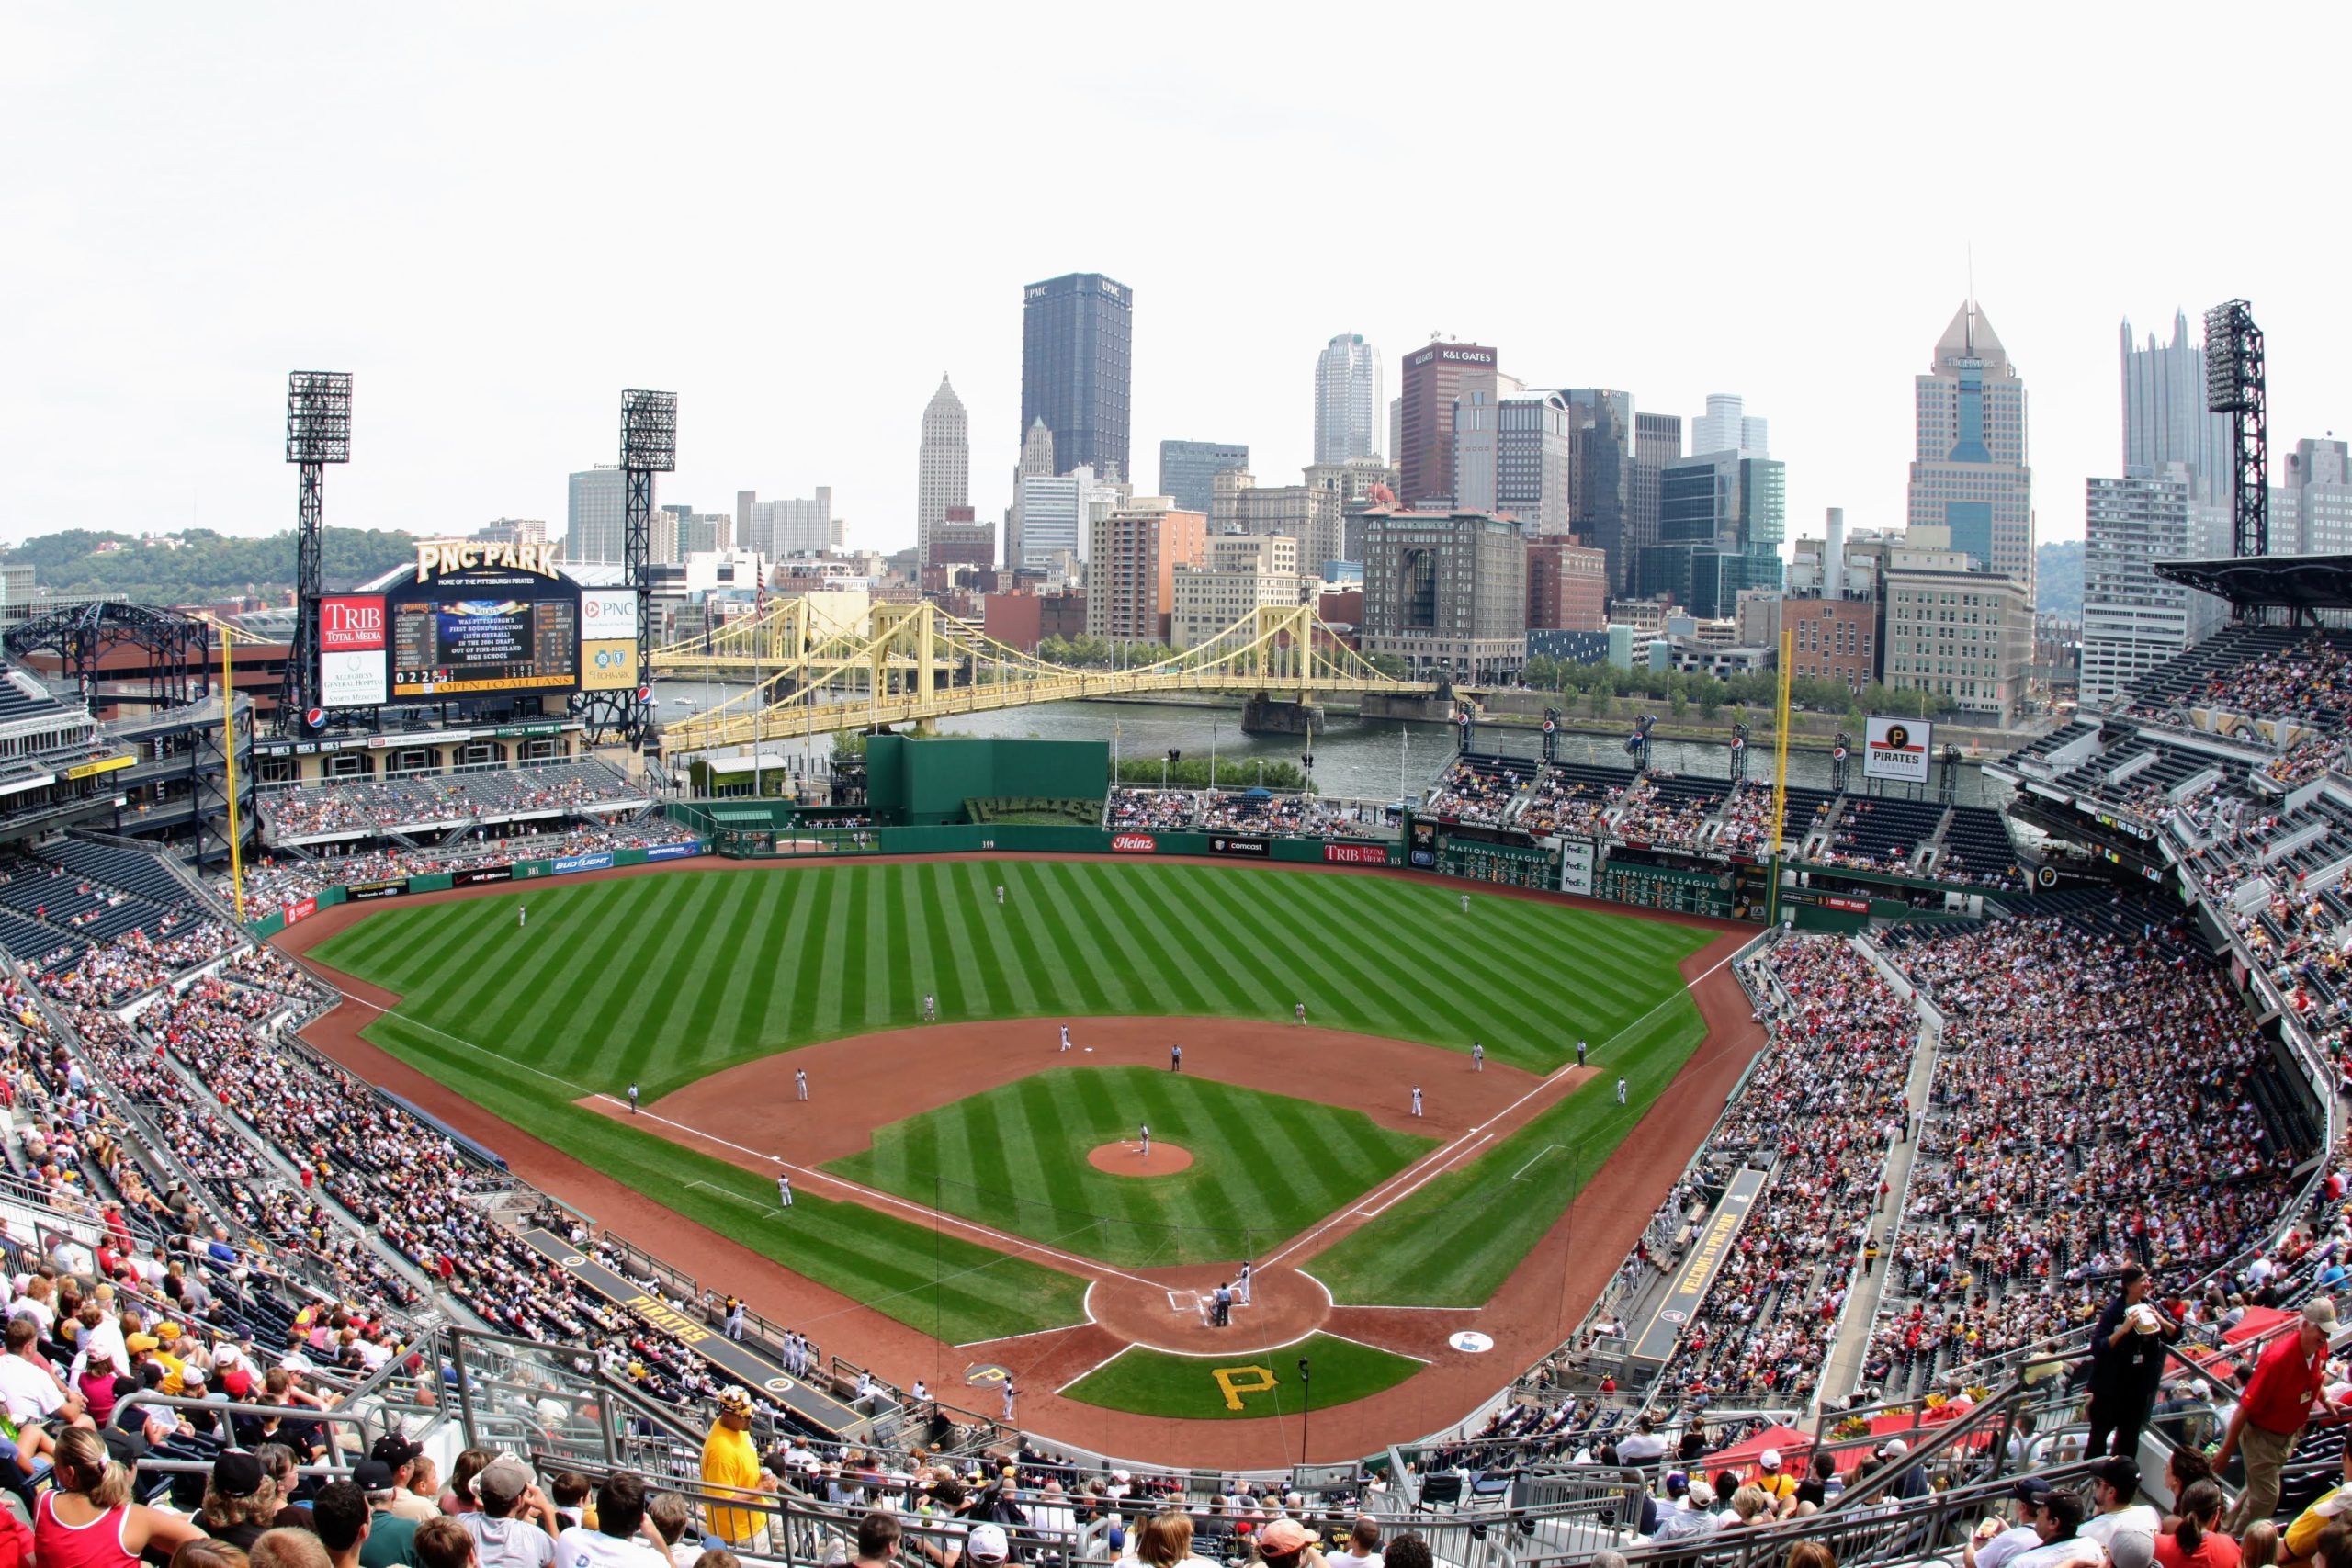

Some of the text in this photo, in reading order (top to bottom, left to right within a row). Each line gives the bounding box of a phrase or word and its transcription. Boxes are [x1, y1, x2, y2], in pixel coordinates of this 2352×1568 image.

[1025, 287, 1047, 299] UPMC
[1102, 280, 1120, 297] UPMC
[1442, 350, 1491, 362] K&L GATES
[417, 543, 559, 584] PNC PARK
[603, 602, 634, 615] PNC
[325, 604, 381, 630] TRIB
[326, 630, 382, 641] TOTAL MEDIA
[396, 671, 429, 683] 0 2 2
[324, 681, 353, 689] GENERAL
[440, 682, 481, 692] OPEN
[485, 681, 504, 689] TO
[507, 678, 533, 688] ALL
[1893, 729, 1904, 745] P
[1874, 751, 1919, 764] PIRATES
[1872, 761, 1918, 772] CHARITIES
[1509, 826, 1529, 834] CONSOL
[981, 840, 994, 849] 399
[1114, 837, 1154, 850] Heinz
[1229, 841, 1263, 852] comcast
[1604, 839, 1626, 847] CONSOL
[1651, 845, 1672, 854] America's
[1325, 844, 1359, 861] TRIB
[1362, 847, 1385, 856] TOTAL
[1449, 845, 1501, 858] NATIONAL
[1505, 852, 1546, 863] LEAGUE
[1567, 845, 1588, 855] FedEx
[555, 856, 610, 869] BUD LIGHT
[1362, 854, 1385, 863] MEDIA
[1707, 852, 1731, 862] CONSOL
[1758, 856, 1770, 864] 320
[527, 867, 539, 876] 383
[1566, 862, 1588, 871] FedEx
[1566, 876, 1586, 887] FedEx
[1608, 868, 1668, 882] AMERICAN
[1671, 876, 1716, 889] LEAGUE
[2044, 871, 2052, 882] P
[1782, 894, 1815, 902] pirates.com
[1714, 1213, 1738, 1232] PARK
[1706, 1231, 1727, 1247] PNC
[1679, 1255, 1714, 1293] WELCOME
[626, 1295, 710, 1343] PIRATES
[770, 1380, 786, 1389] P
[1211, 1365, 1280, 1411] P
